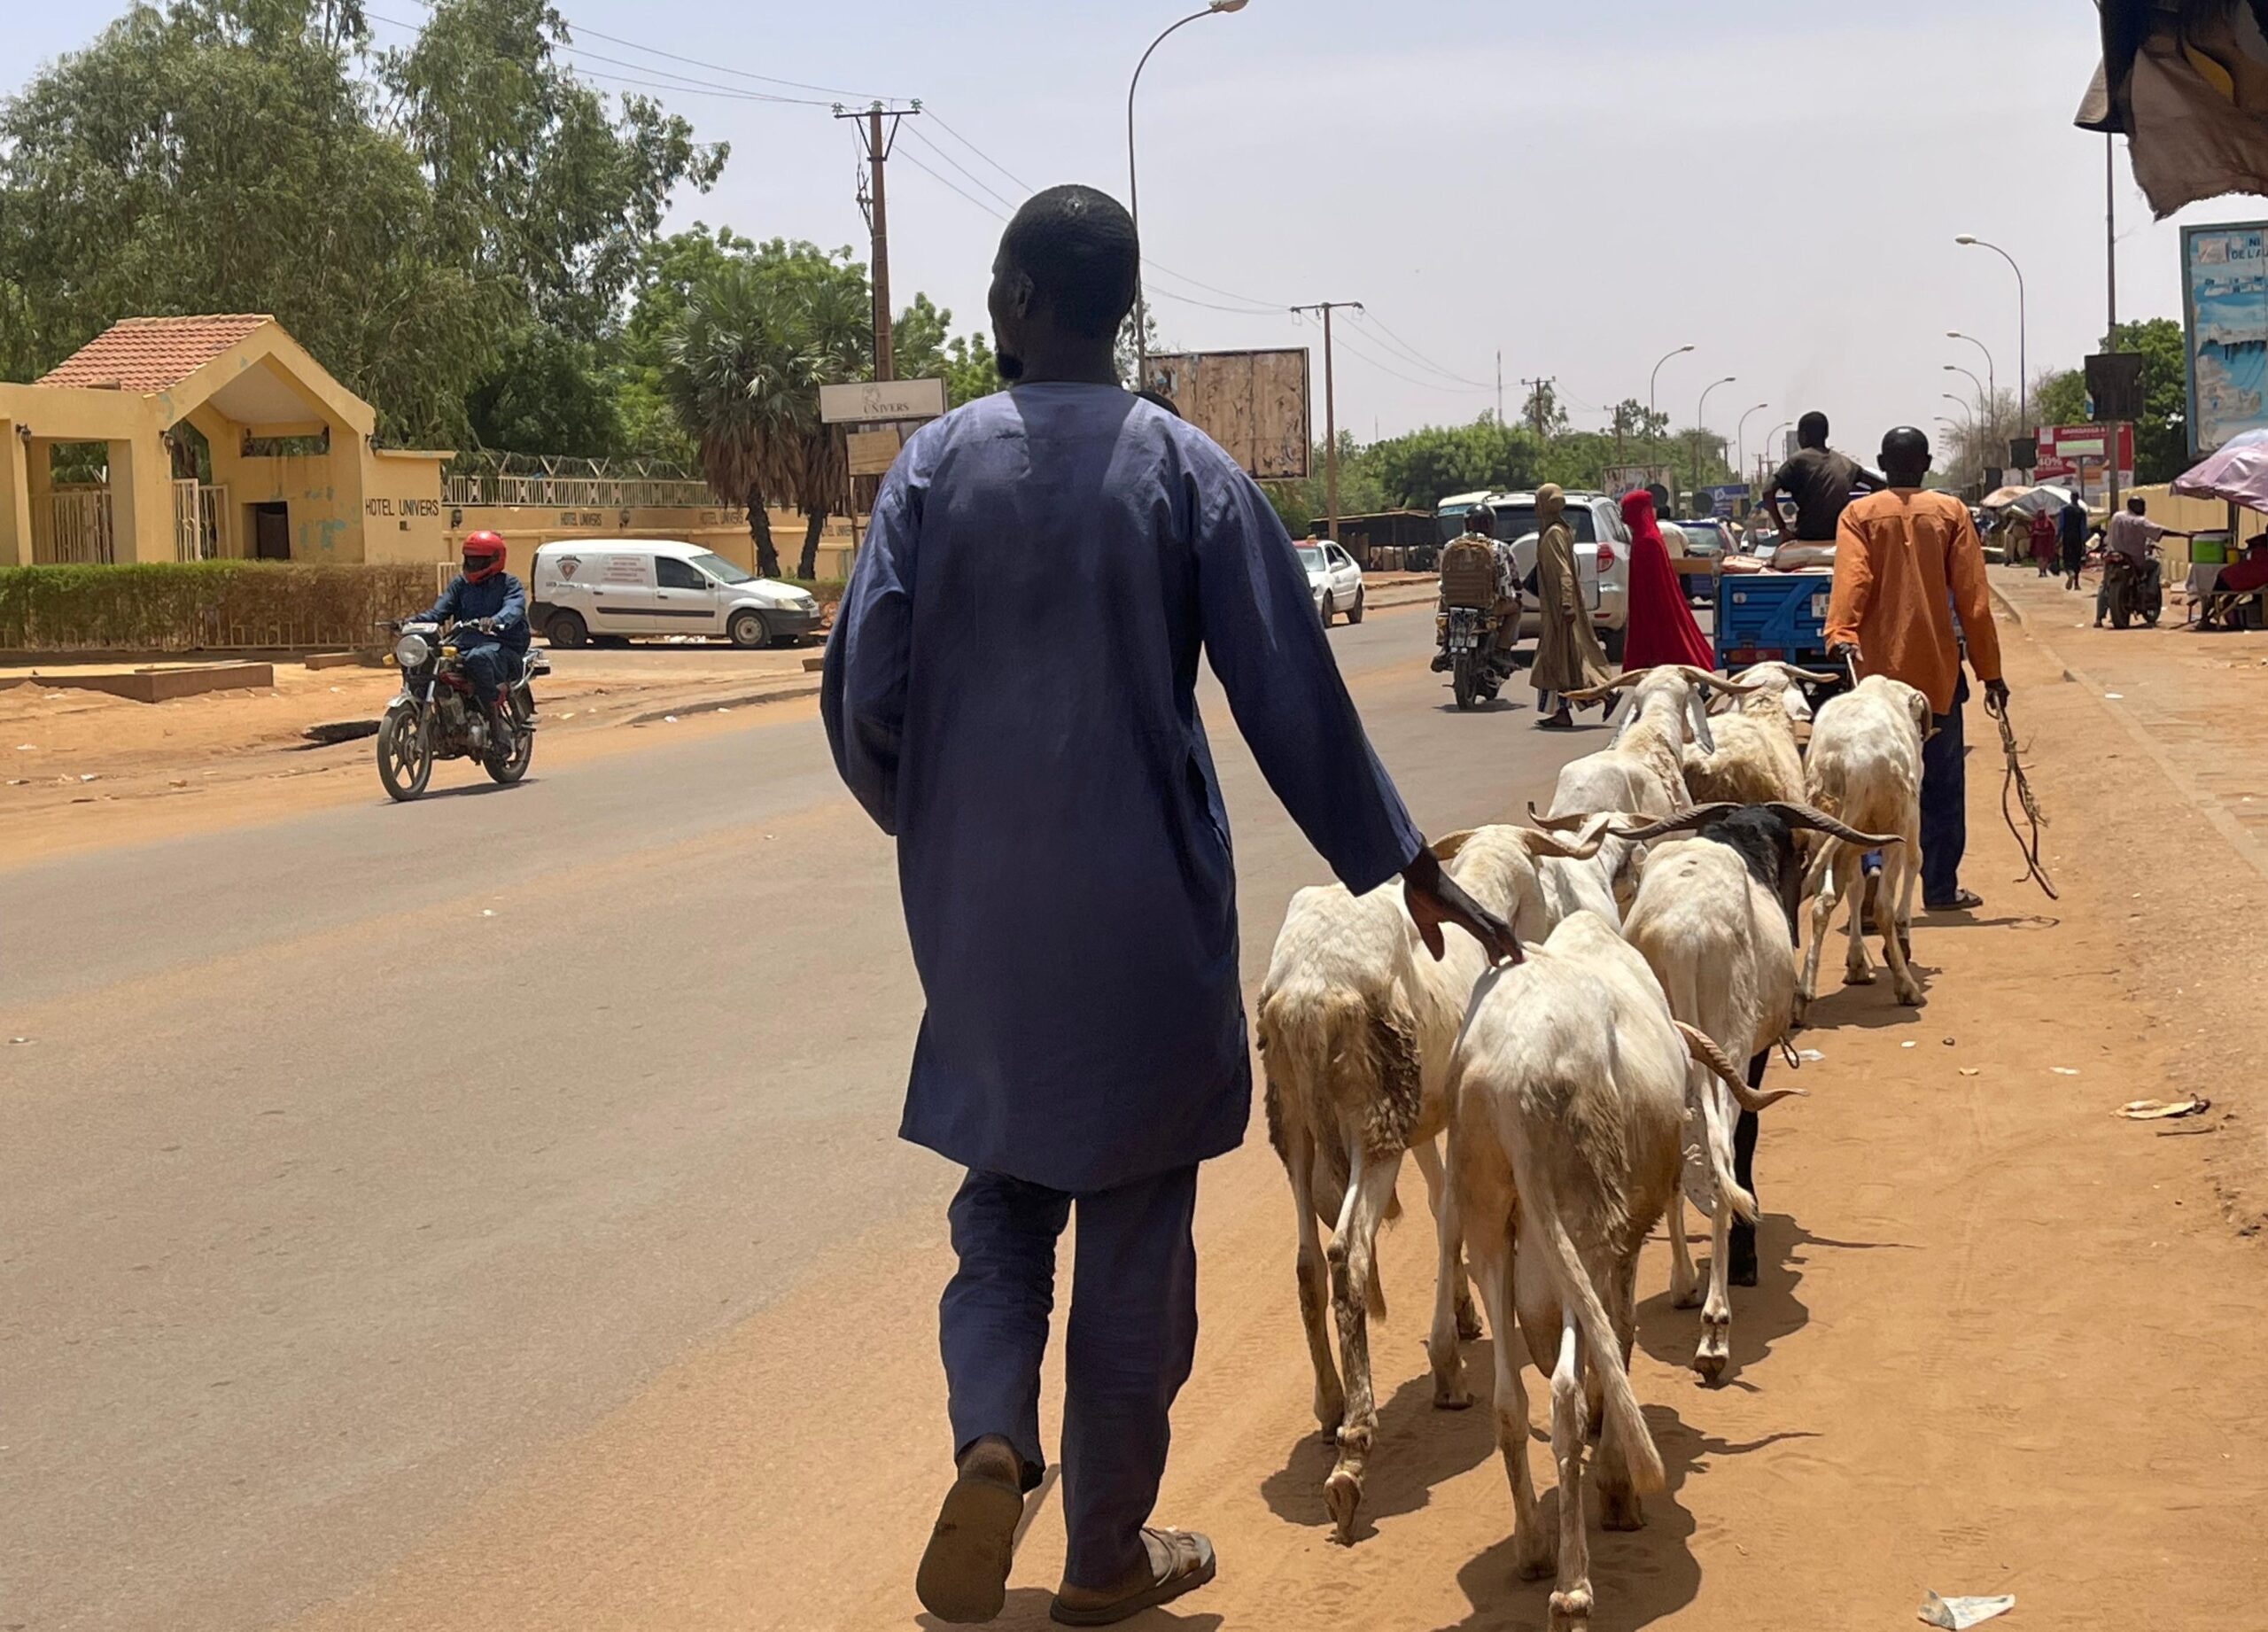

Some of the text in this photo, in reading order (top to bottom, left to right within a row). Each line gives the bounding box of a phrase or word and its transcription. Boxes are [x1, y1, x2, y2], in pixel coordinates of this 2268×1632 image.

[864, 403, 909, 415] UNIVERS
[365, 498, 439, 517] HOTEL UNIVERS
[560, 511, 602, 527] HOTEL UNIVERS
[700, 510, 744, 525] HOTEL UNIVERS
